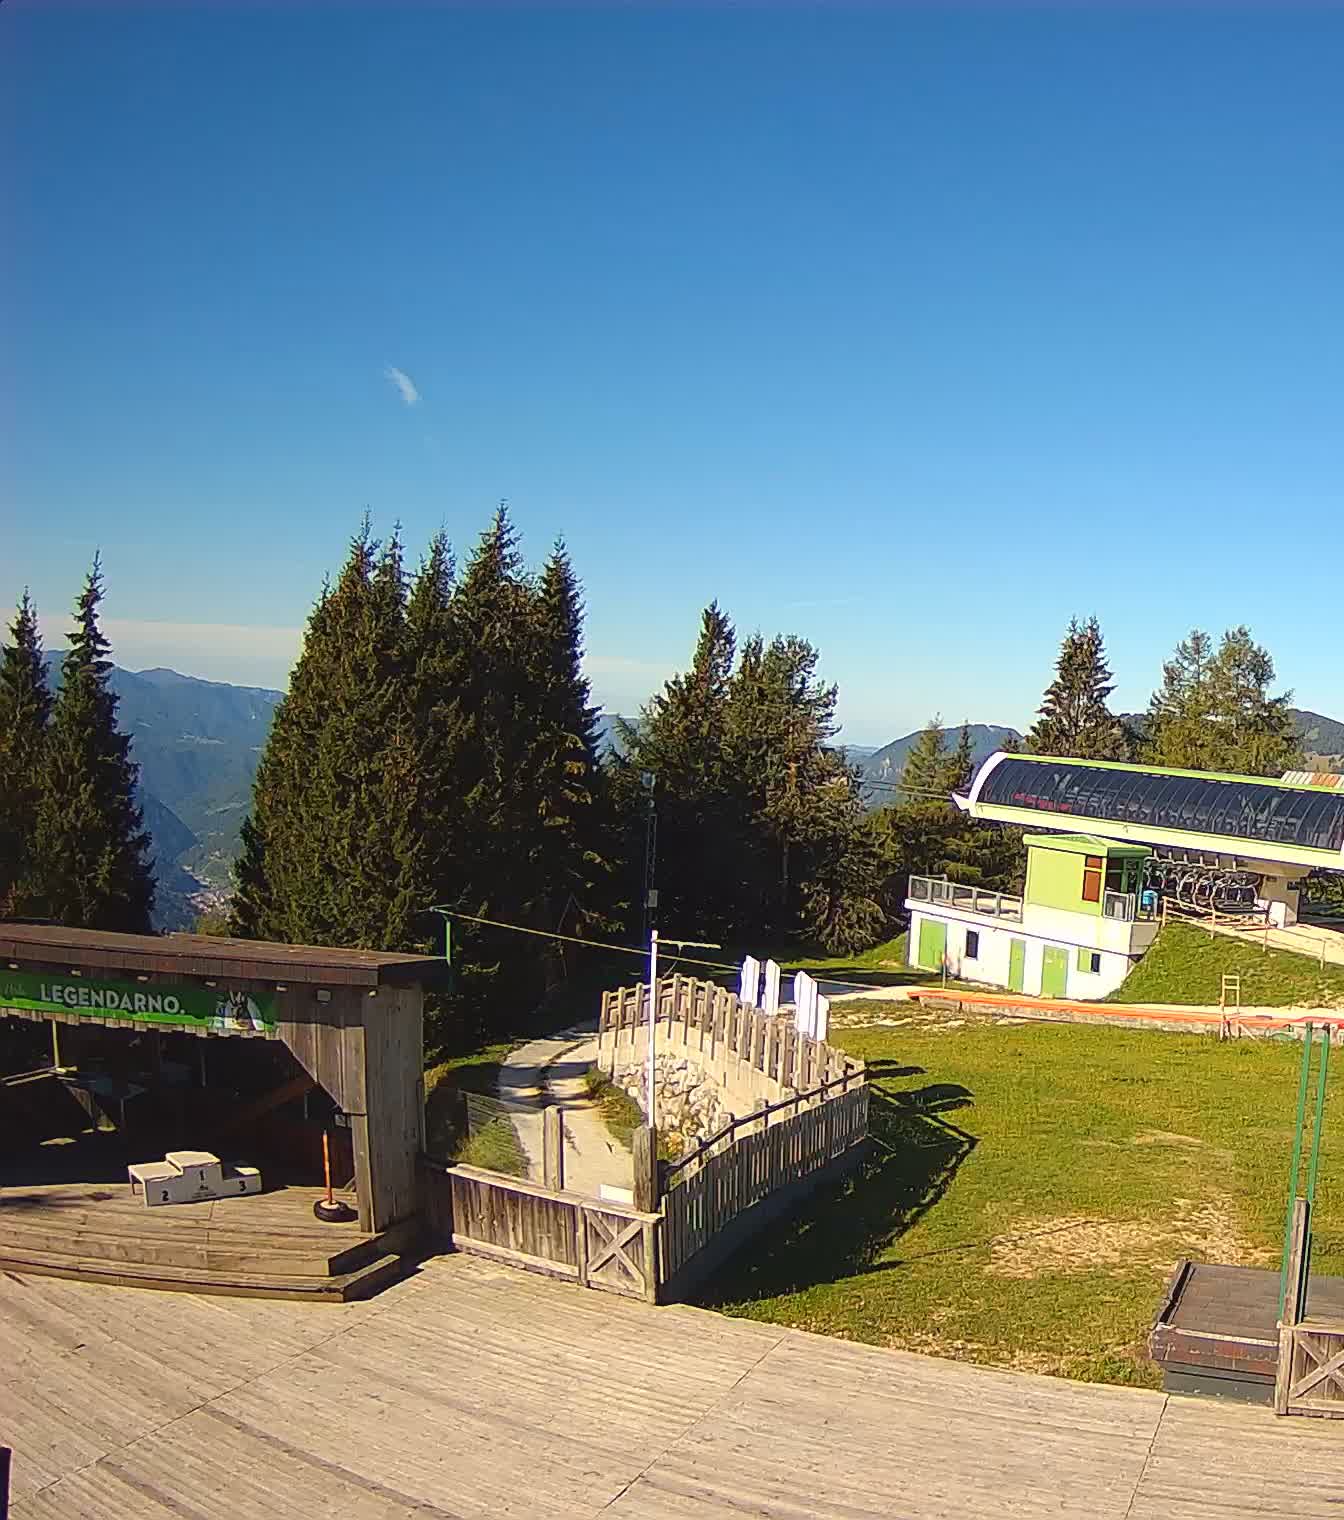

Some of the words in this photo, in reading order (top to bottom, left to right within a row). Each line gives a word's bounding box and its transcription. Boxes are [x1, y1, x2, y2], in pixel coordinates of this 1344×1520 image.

[40, 983, 186, 1014] LEGENDARNO.
[238, 1180, 247, 1192] 3
[161, 1190, 169, 1202] 2
